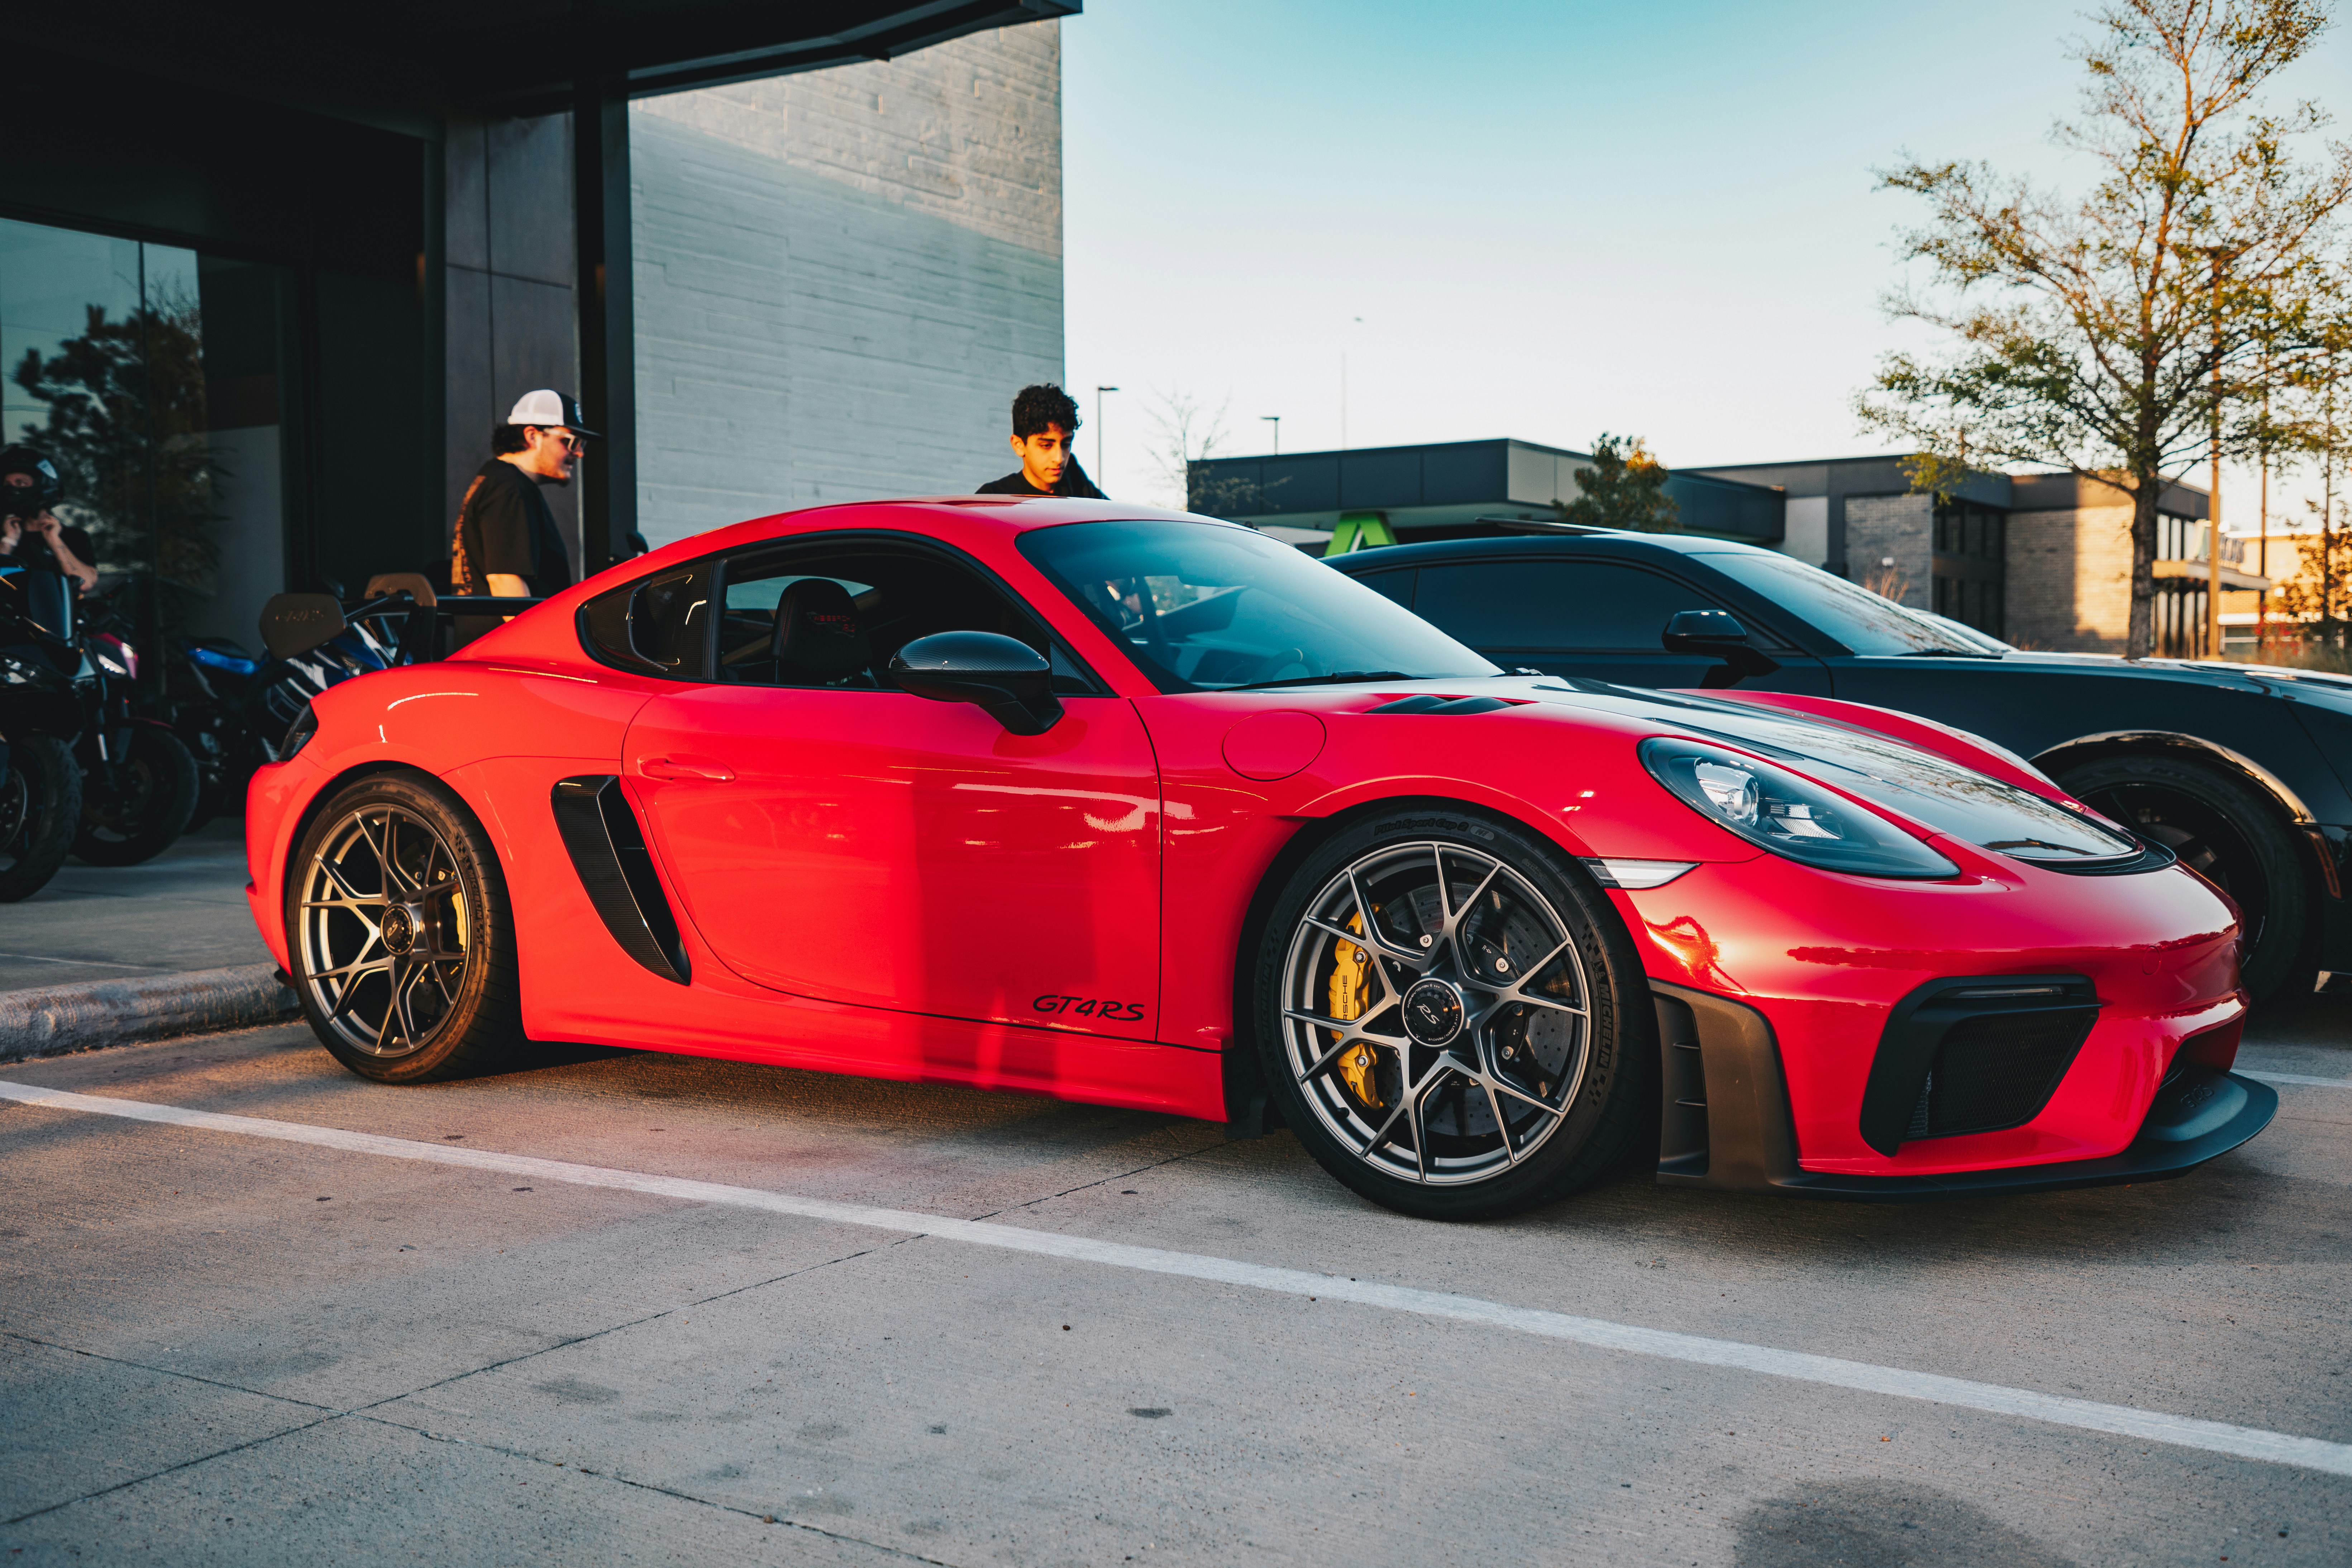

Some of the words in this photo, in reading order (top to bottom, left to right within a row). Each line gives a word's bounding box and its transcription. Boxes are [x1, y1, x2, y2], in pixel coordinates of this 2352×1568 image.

[1374, 820, 1402, 836] Pilot
[1401, 818, 1435, 830] Sport
[1435, 819, 1457, 830] Cup
[1457, 822, 1469, 832] 2
[1417, 1004, 1440, 1024] RS
[1599, 983, 1612, 1069] MICHELIN
